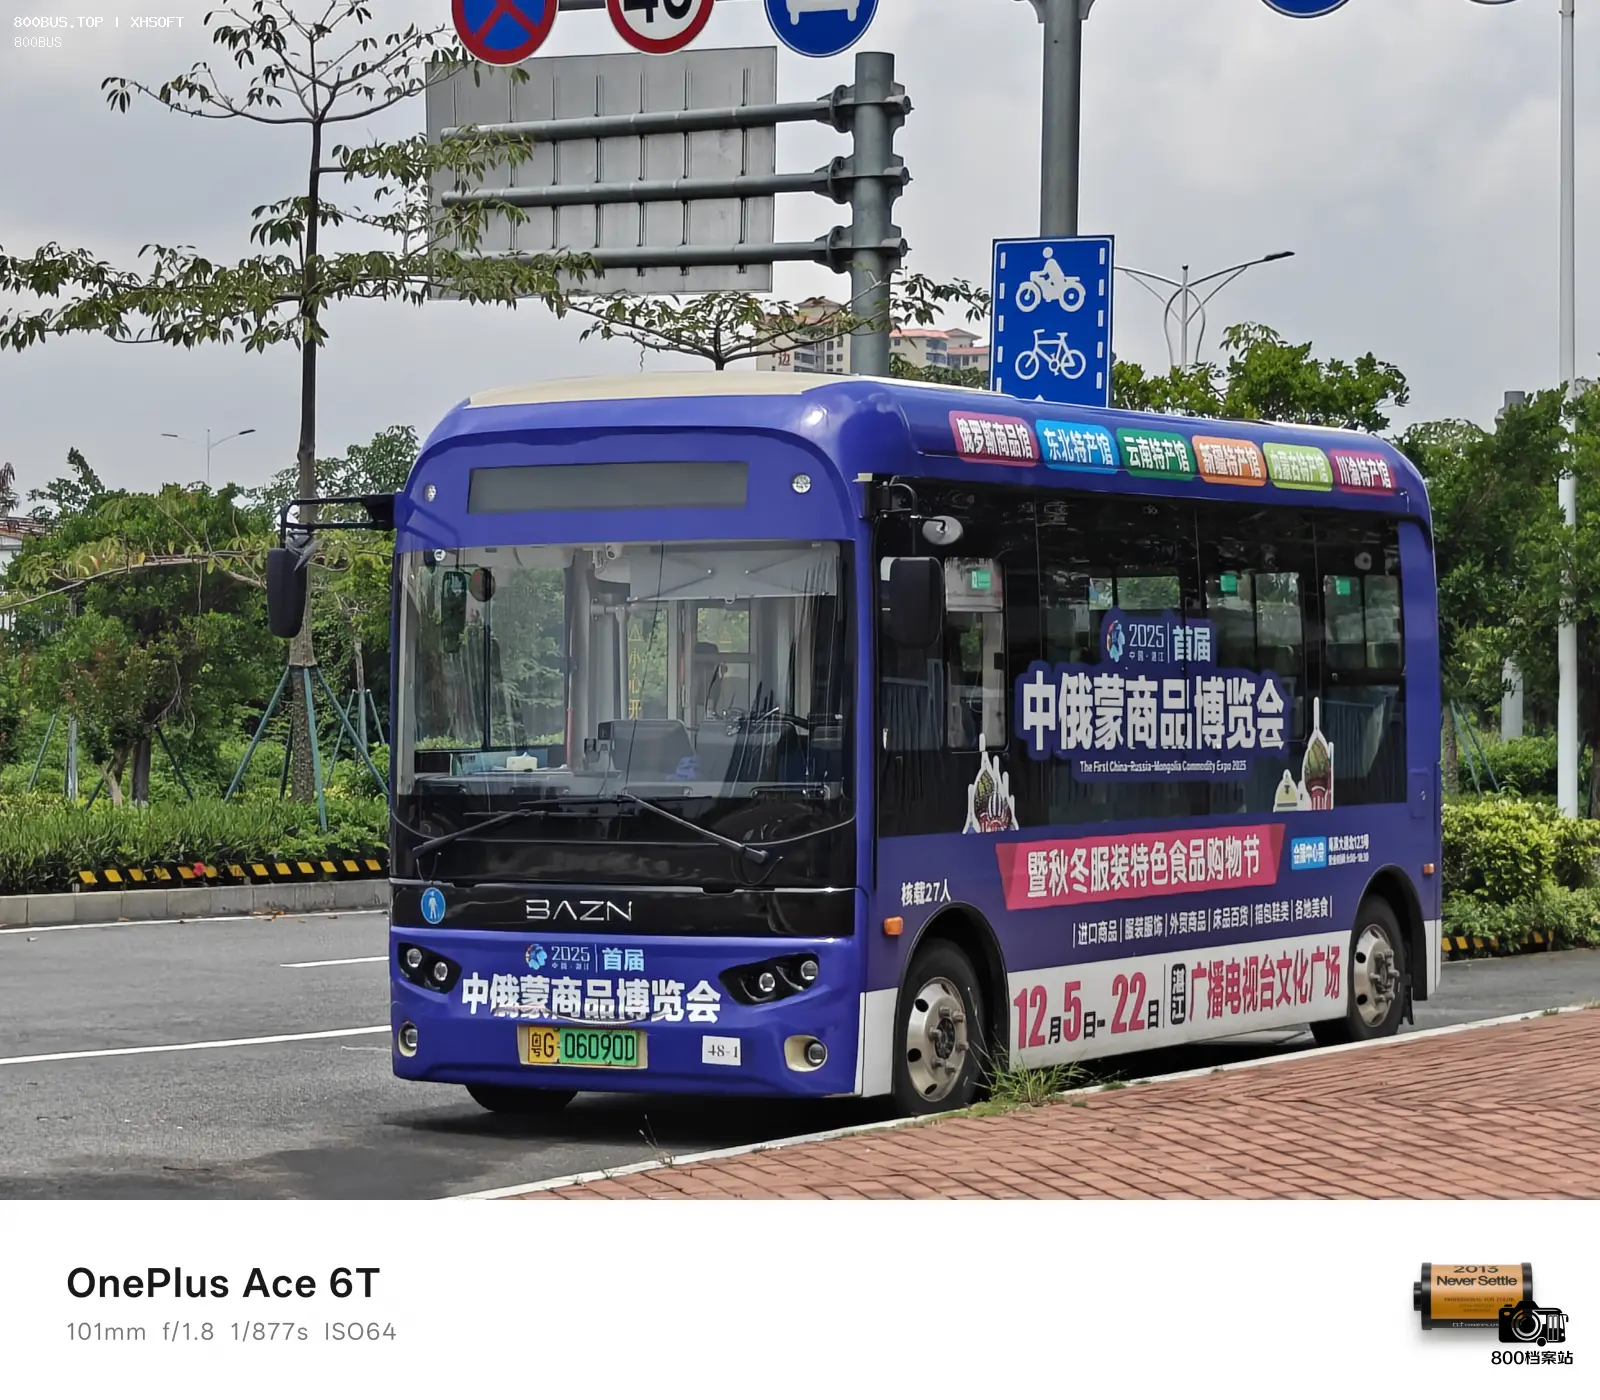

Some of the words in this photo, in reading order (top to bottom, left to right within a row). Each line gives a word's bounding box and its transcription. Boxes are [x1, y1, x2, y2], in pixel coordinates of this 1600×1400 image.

[955, 417, 1034, 459] 俄罗斯商品馆
[1043, 427, 1115, 467] 东北特产馆
[1123, 436, 1191, 473] 云南特产馆
[1199, 442, 1262, 479] 新疆特产馆
[1335, 455, 1392, 489] 川渝特产馆
[1128, 624, 1165, 648] 2025
[1172, 625, 1211, 662] 首届
[1022, 670, 1285, 750] 中俄蒙商品博览会
[1079, 760, 1093, 773] The
[1093, 760, 1109, 773] First
[1182, 760, 1215, 774] Commodity
[1216, 760, 1231, 772] Expo
[1026, 833, 1260, 898] 暨秋冬服装特色食品购物节
[901, 878, 952, 907] 核载27人
[525, 899, 633, 922] BAZN
[1077, 919, 1118, 946] 进口商品
[551, 945, 591, 962] 2025
[601, 947, 645, 972] 首届
[462, 972, 721, 1024] 中俄蒙商品博览会
[1189, 944, 1341, 1022] 广播电视台文化广场
[707, 1043, 738, 1058] 48-1
